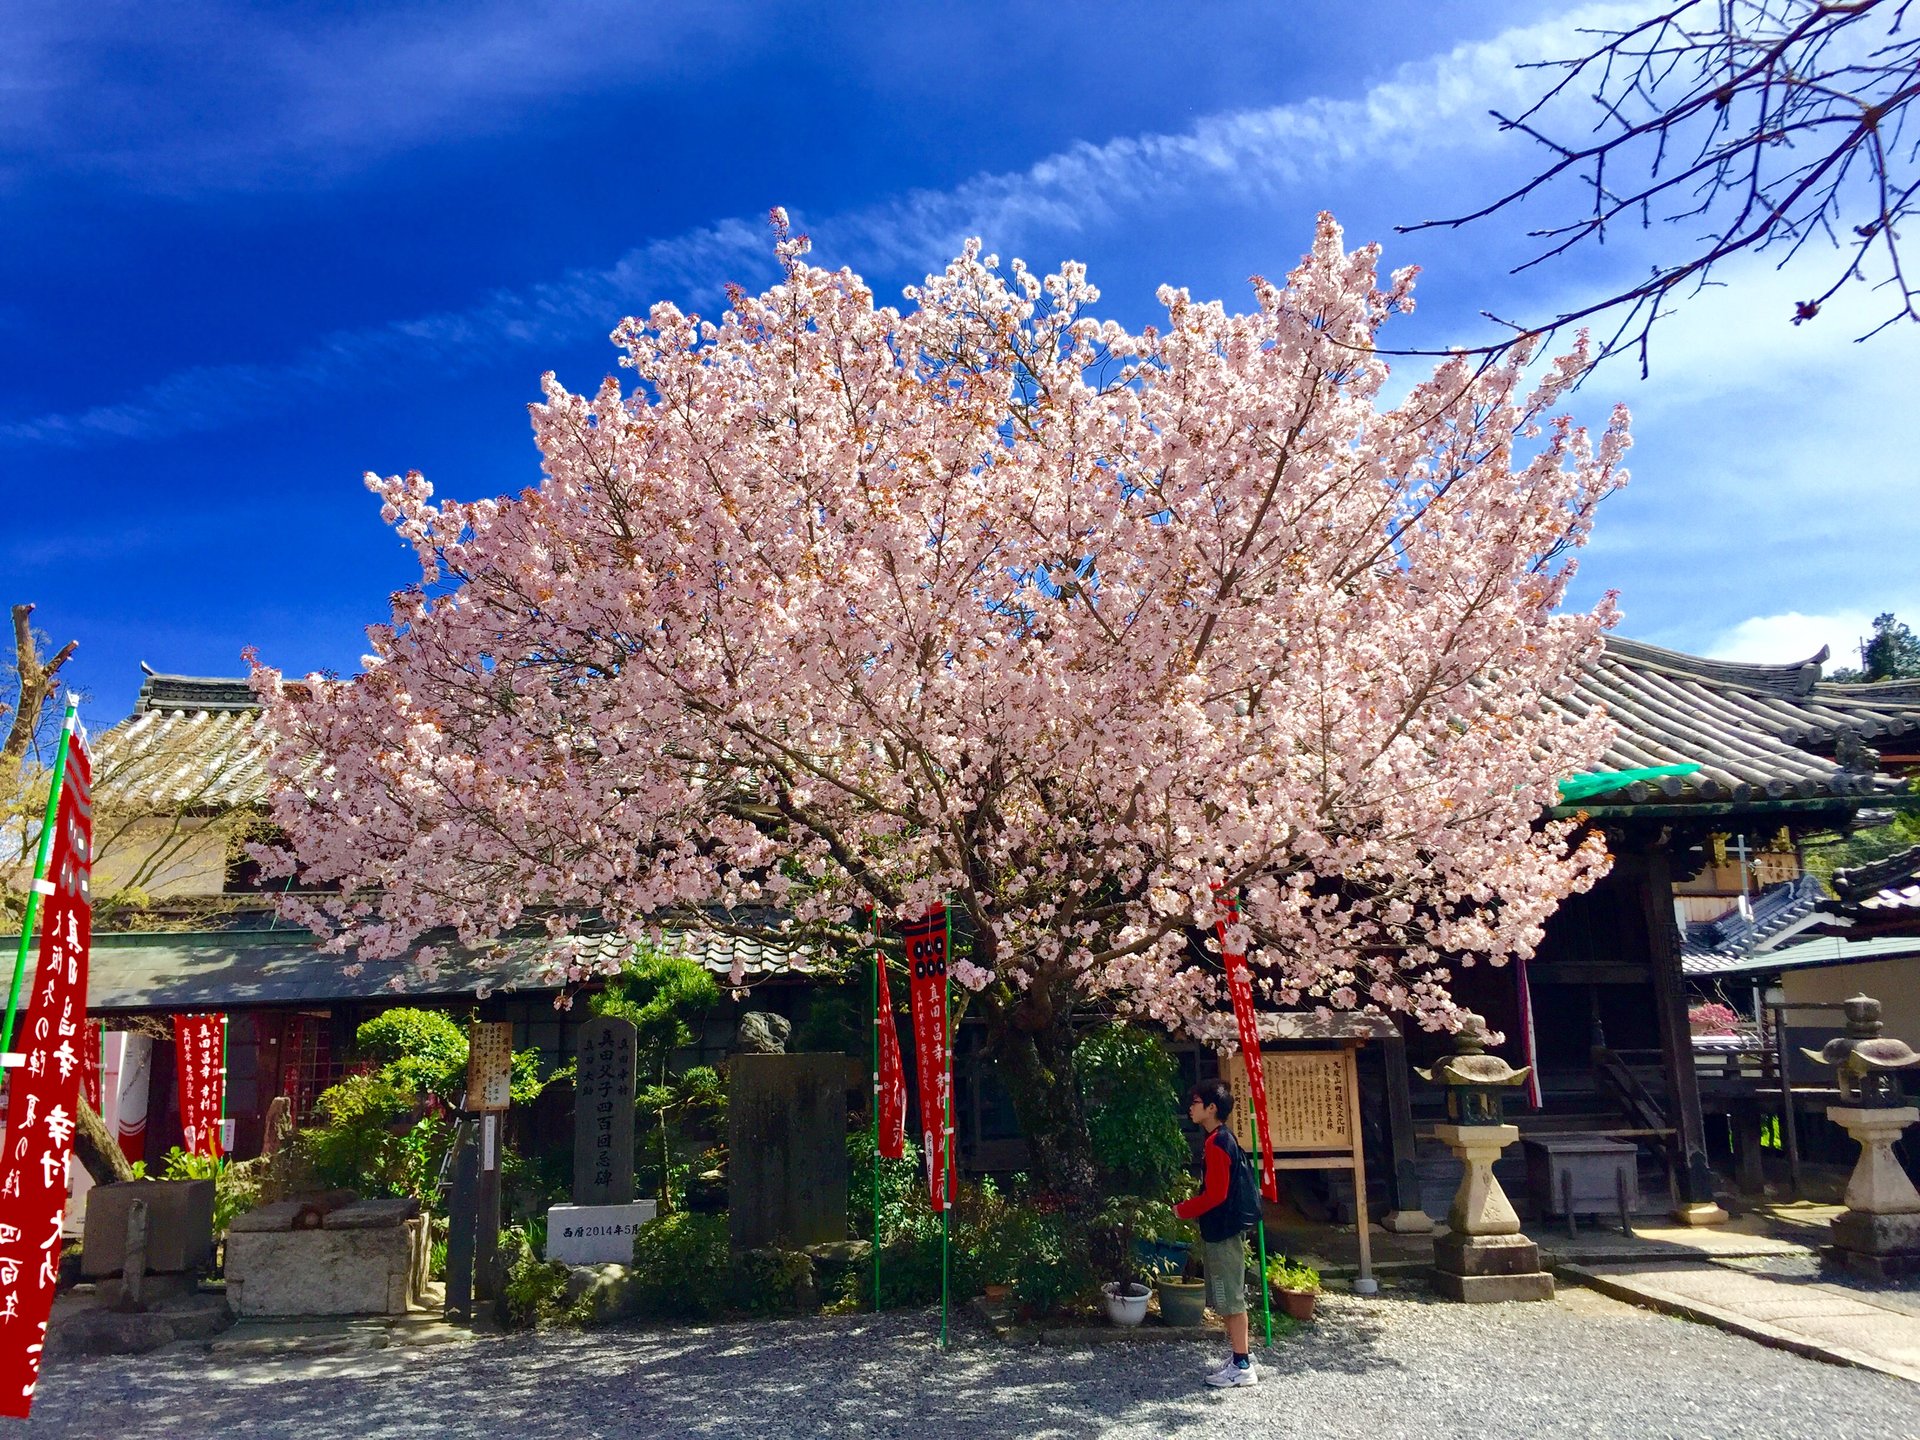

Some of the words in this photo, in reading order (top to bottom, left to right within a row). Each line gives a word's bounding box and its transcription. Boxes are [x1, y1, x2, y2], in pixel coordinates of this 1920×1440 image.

[197, 1023, 211, 1080] 真田昌幸
[928, 982, 945, 1064] 真田昌幸
[582, 1039, 595, 1097] 真田大助
[617, 1038, 629, 1097] 真田幸村
[935, 1071, 946, 1110] 幸村
[200, 1085, 211, 1112] 幸村
[594, 1028, 615, 1188] 真田父子四百回忌碑
[1333, 1061, 1345, 1135] 九度山町指定文化財
[563, 1224, 639, 1238] 西暦2014年5月
